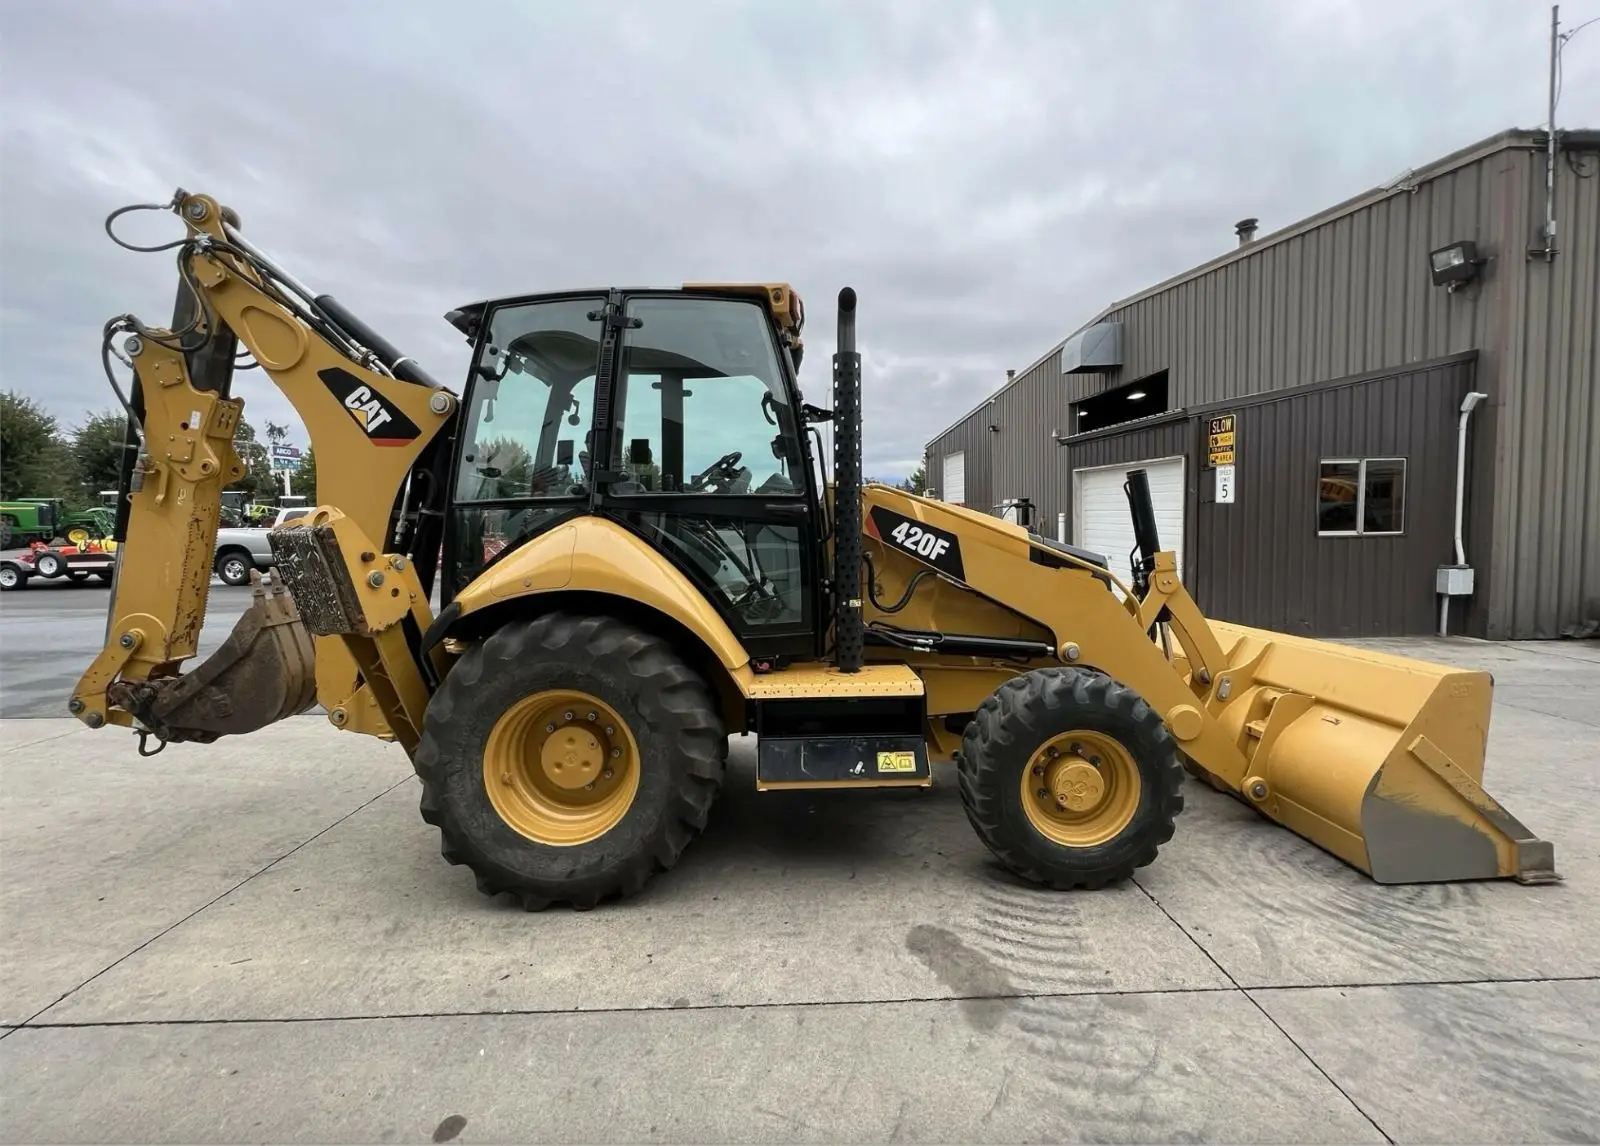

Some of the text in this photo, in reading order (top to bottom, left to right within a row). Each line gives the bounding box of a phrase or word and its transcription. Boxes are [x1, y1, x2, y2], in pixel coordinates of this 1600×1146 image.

[344, 385, 393, 433] CAT
[1212, 418, 1232, 433] SLOW
[275, 447, 292, 456] ARCO
[1222, 484, 1228, 498] 5
[891, 521, 950, 561] 420F
